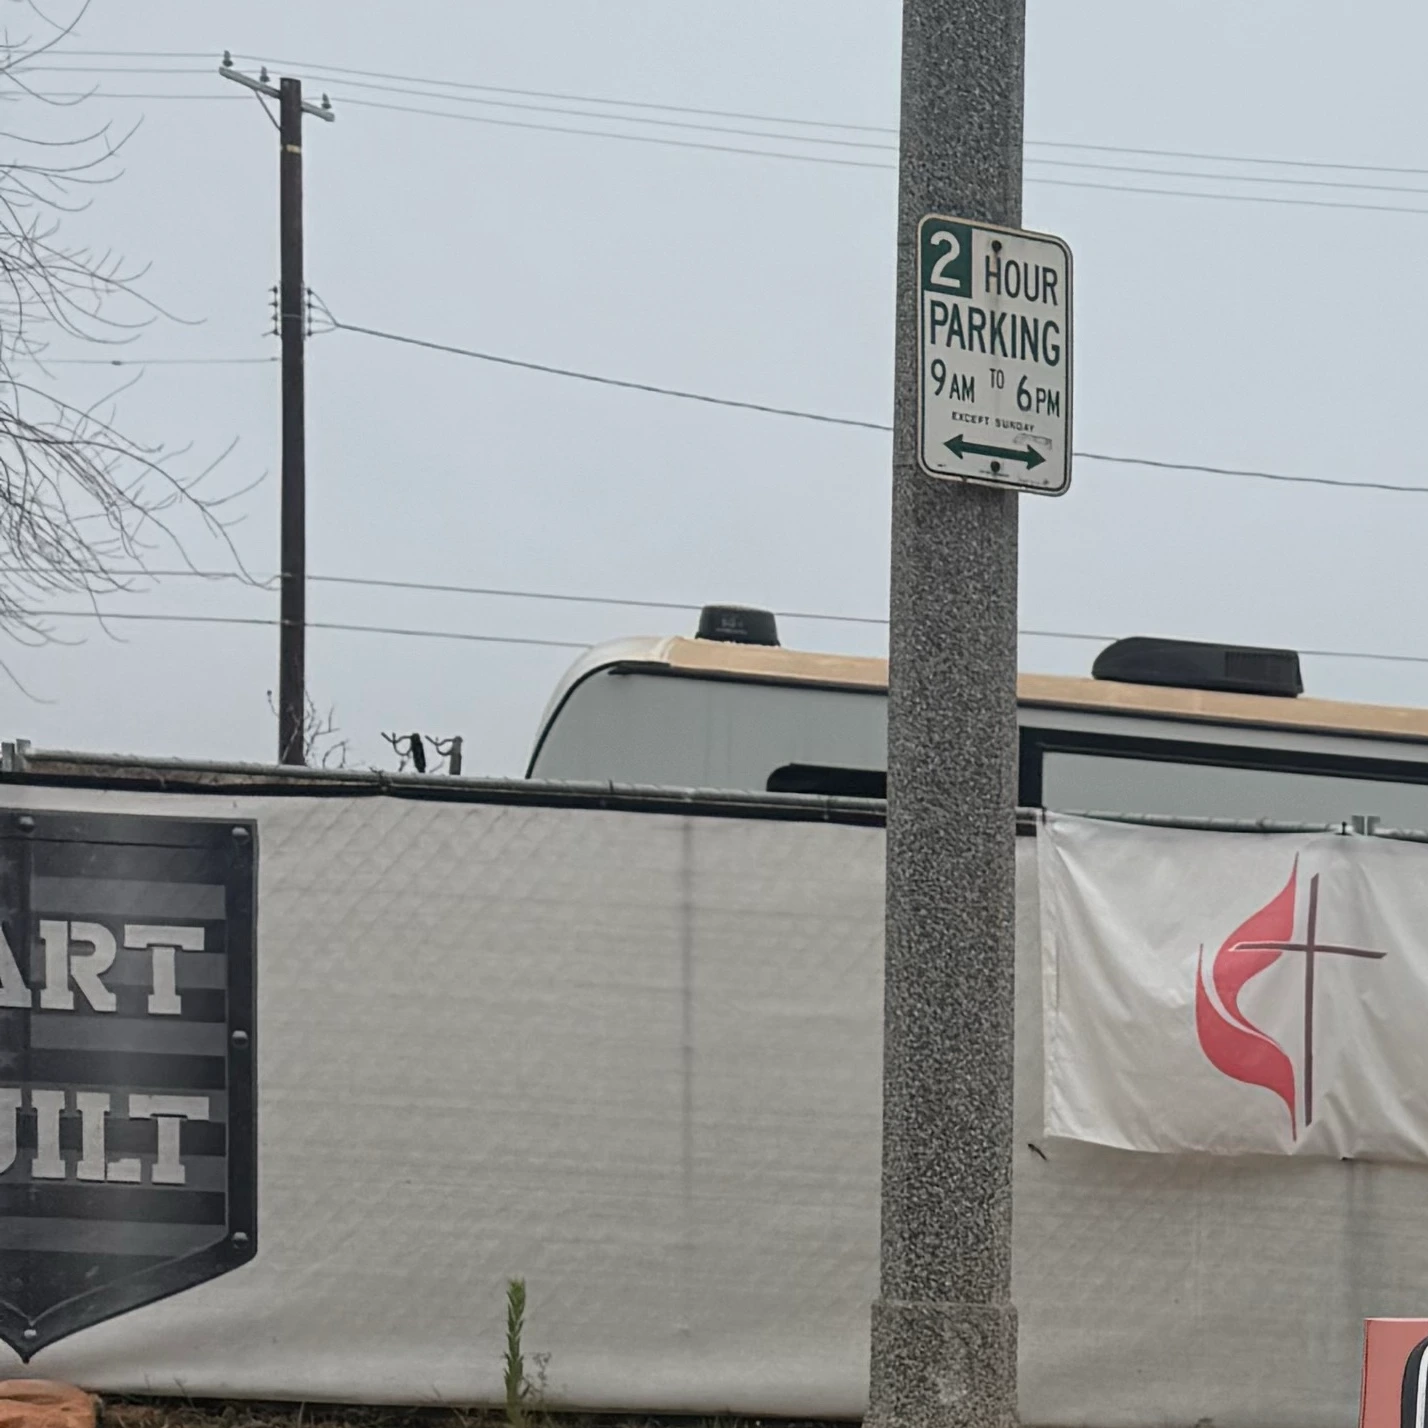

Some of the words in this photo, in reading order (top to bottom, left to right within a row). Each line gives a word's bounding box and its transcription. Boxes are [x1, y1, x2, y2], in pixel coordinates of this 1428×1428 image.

[930, 231, 961, 288] 2
[984, 254, 1059, 306] HOUR
[929, 299, 1061, 367] PARKING
[989, 368, 1004, 389] TO
[952, 411, 990, 426] EXCEPT
[995, 418, 1035, 432] SUNDAY
